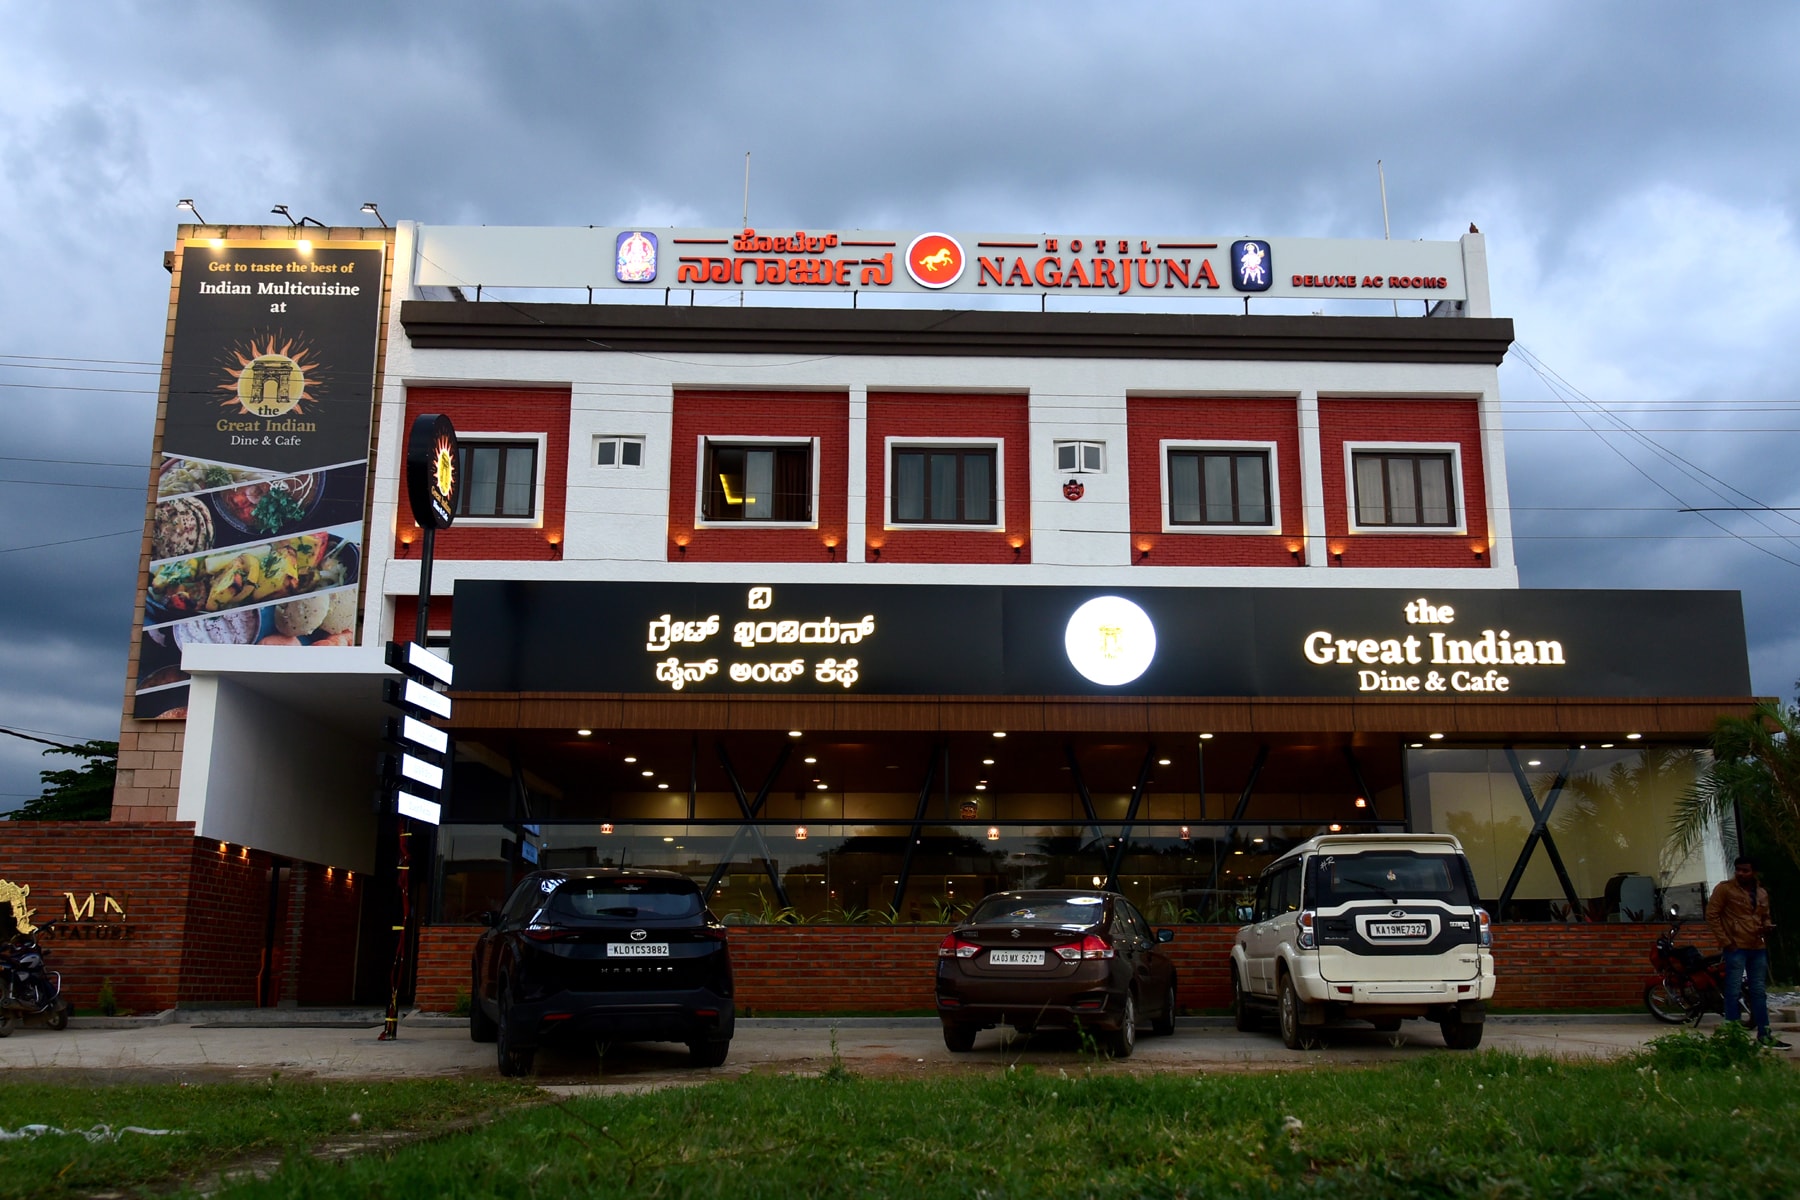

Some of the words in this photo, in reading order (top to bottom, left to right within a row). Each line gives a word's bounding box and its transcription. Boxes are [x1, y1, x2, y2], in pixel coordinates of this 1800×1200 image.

[733, 228, 838, 253] ಹೋಟೆಲ್
[1045, 239, 1151, 254] HOTEL
[208, 261, 231, 272] Get
[234, 262, 248, 272] to
[250, 262, 283, 272] taste
[286, 261, 307, 272] the
[310, 262, 337, 273] best
[340, 262, 355, 274] of
[677, 252, 893, 286] ನಾಗಾರ್ಜುನ
[977, 256, 1220, 295] NAGARJUNA
[1292, 275, 1357, 288] DELUXE
[1361, 276, 1384, 288] AC
[1388, 276, 1448, 289] ROOMS
[199, 281, 251, 295] Indian
[257, 282, 361, 296] Multicuisine
[270, 301, 287, 313] at
[258, 405, 280, 416] the
[216, 419, 261, 432] Great
[265, 419, 316, 432] Indian
[231, 435, 259, 446] Dine
[261, 436, 272, 446] &
[275, 435, 302, 446] Cafe
[1404, 598, 1455, 624] the
[647, 614, 720, 652] ಗ್ರೇಟ್
[733, 614, 875, 648] ಇಂಡಿಯನ್
[1303, 631, 1422, 665] Great
[1429, 629, 1566, 665] Indian
[656, 657, 718, 691] ಡೈನ್
[729, 658, 805, 682] ಅಂಡ್
[815, 657, 859, 688] ಕೆಫೆ
[1358, 670, 1420, 692] Dine
[1424, 671, 1446, 691] &
[1451, 670, 1510, 692] Cafe
[1375, 926, 1426, 934] KA19ME7327
[614, 946, 667, 954] KL01CS3882
[1021, 954, 1038, 963] 5272
